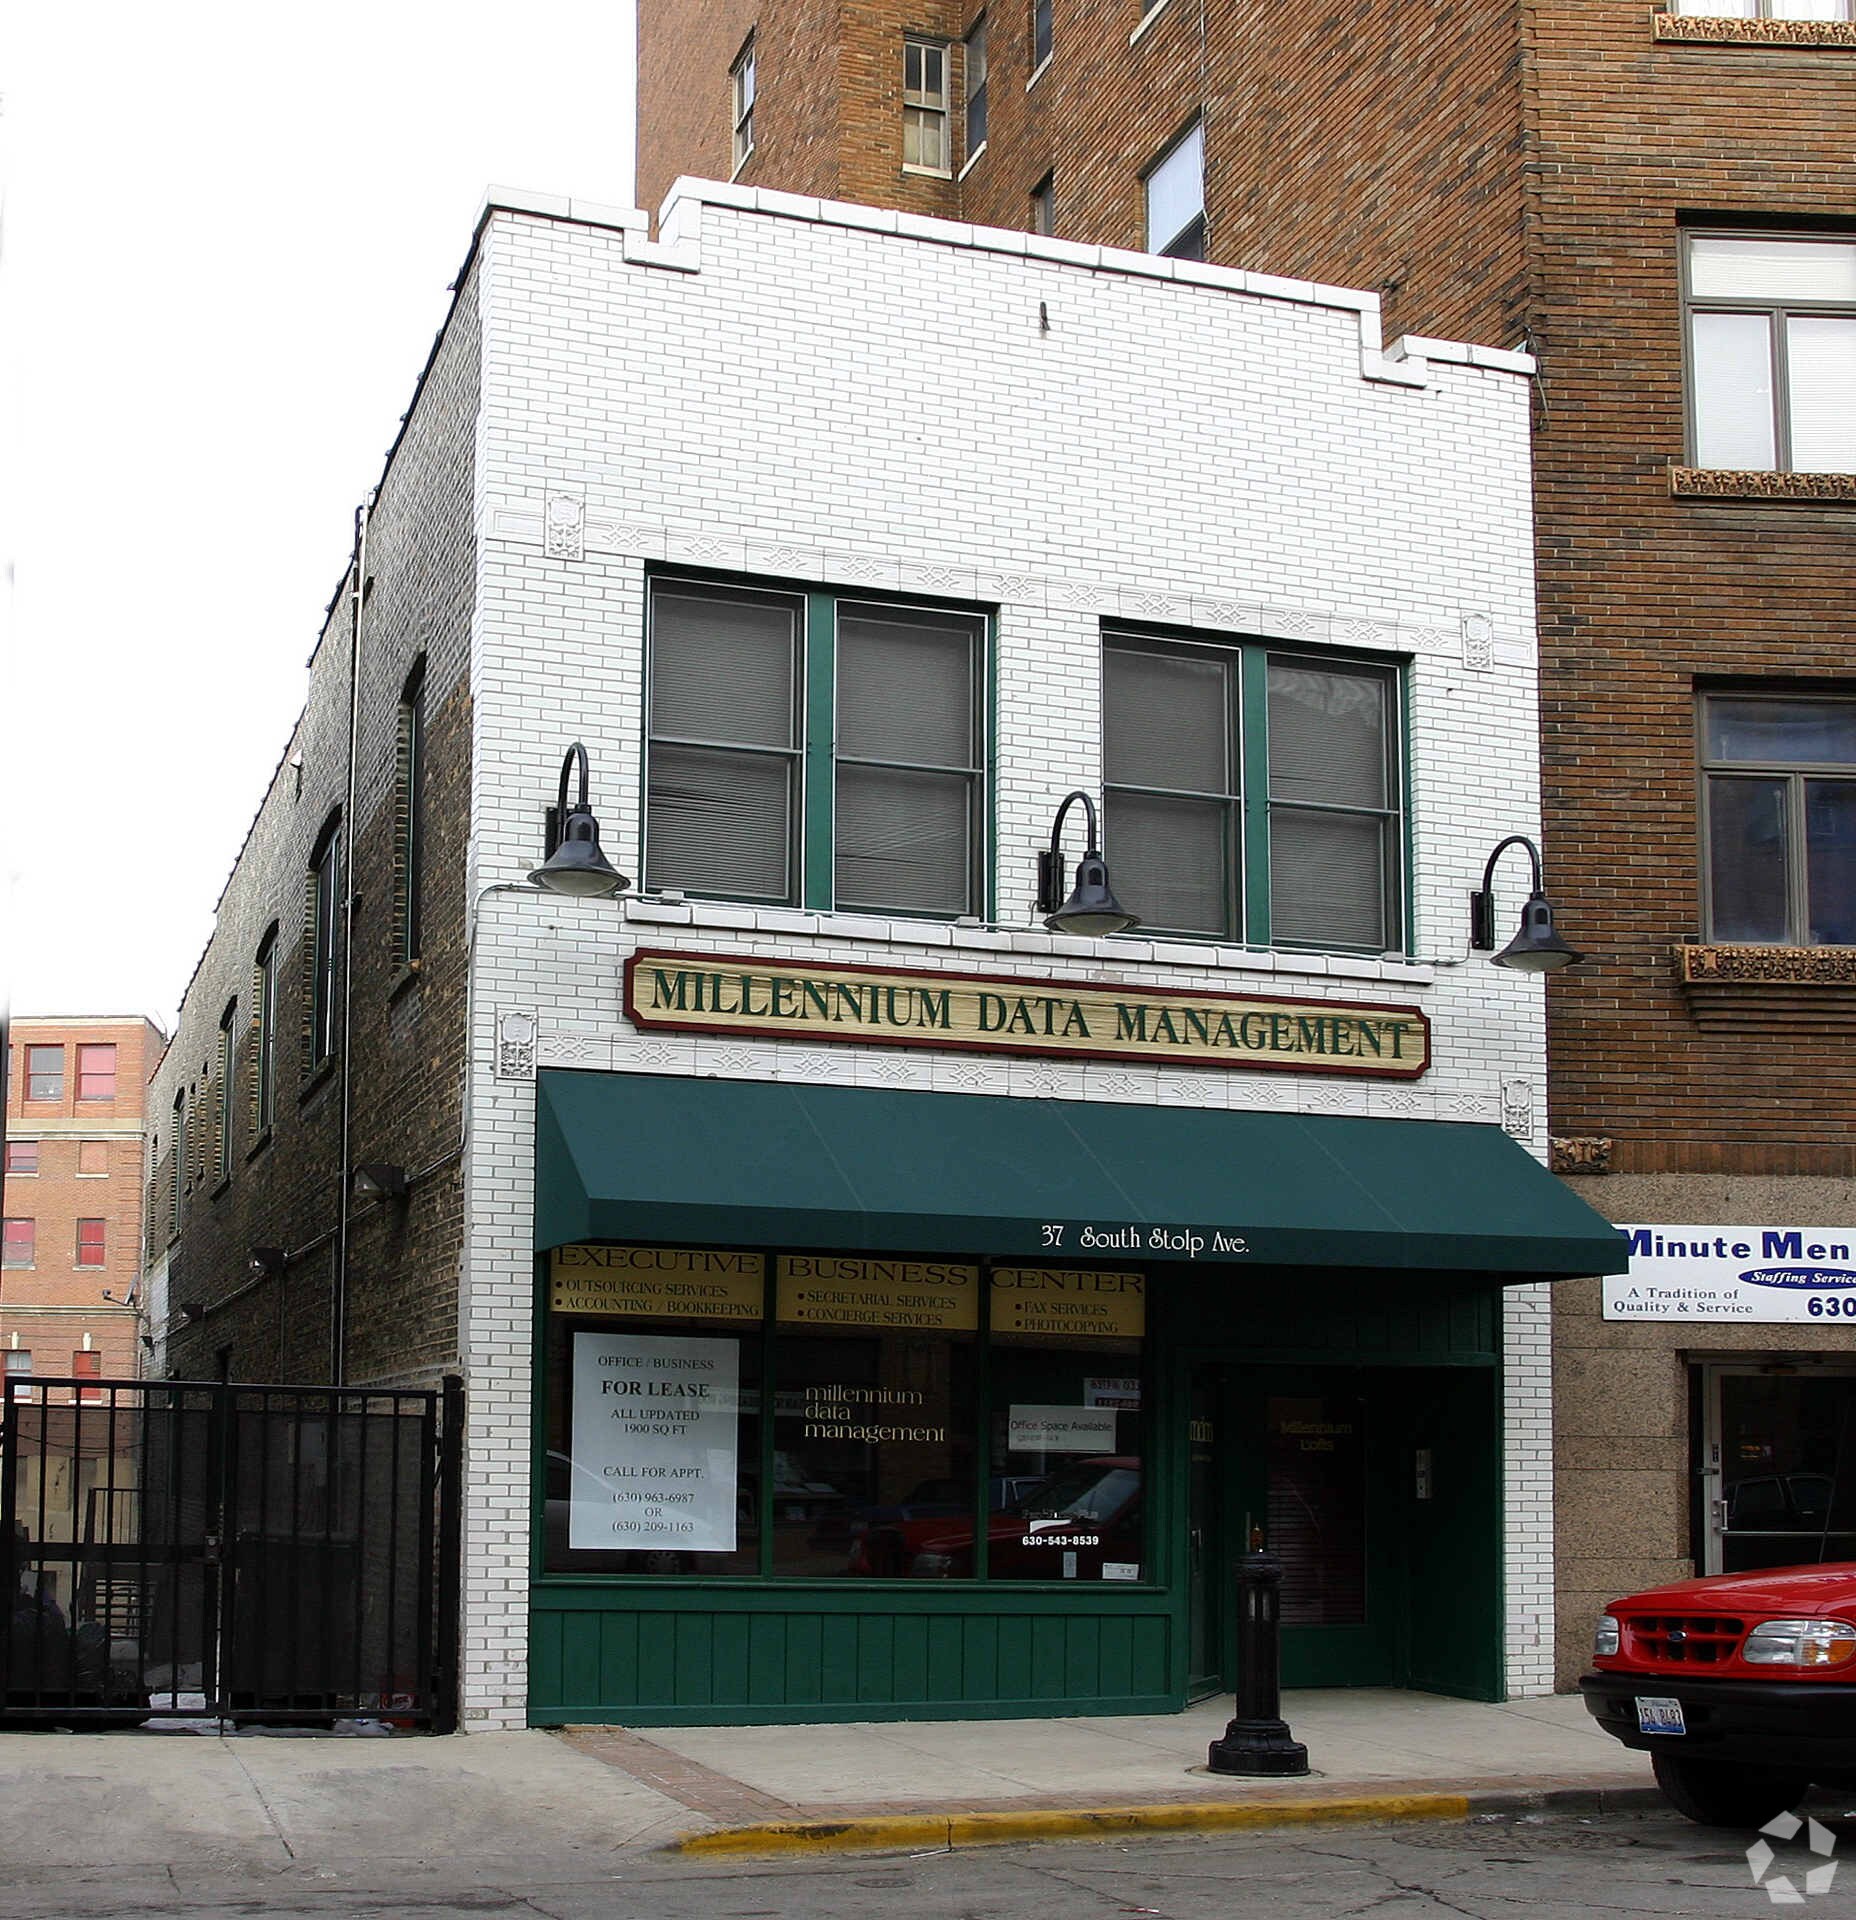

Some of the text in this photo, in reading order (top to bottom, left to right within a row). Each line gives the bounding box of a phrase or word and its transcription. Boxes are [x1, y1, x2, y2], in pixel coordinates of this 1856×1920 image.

[650, 968, 1409, 1060] MILLENNIUM DATA MANAGEMENT
[1041, 1225, 1250, 1259] 37 South Stolp Ave.
[1616, 1229, 1850, 1260] Minute Men
[557, 1247, 759, 1274] EXECUTIVE
[787, 1258, 969, 1285] BUSINESS
[1751, 1271, 1807, 1285] Staffing
[566, 1279, 729, 1298] OUTSOURCING SERVICES
[990, 1269, 1145, 1294] CENTER
[807, 1289, 957, 1309] SECRETARIAL SERVICES
[1629, 1287, 1739, 1300] A Tradition of
[566, 1297, 652, 1312] ACCOUNTING
[667, 1300, 760, 1317] BOOKKEEPING
[807, 1306, 943, 1326] CONCIERGE SERVICES
[1051, 1302, 1109, 1316] SERVICES
[1614, 1301, 1753, 1315] Quality & Service
[1807, 1296, 1856, 1318] 630
[1024, 1317, 1119, 1334] PHOTOCOPYING
[598, 1356, 643, 1367] OFFICE
[653, 1358, 715, 1370] BUSINESS
[602, 1380, 711, 1398] FOR LEASE
[804, 1384, 923, 1405] millennium
[611, 1409, 701, 1421] ALL UPDATED
[805, 1402, 851, 1420] data
[624, 1424, 688, 1437] 1900 SQ FT
[804, 1423, 946, 1444] management
[1010, 1421, 1039, 1431] Office
[1041, 1421, 1069, 1433] Space
[603, 1466, 705, 1479] CALL FOR APPT.
[612, 1493, 642, 1504] (630)
[644, 1507, 663, 1518] OR
[612, 1522, 641, 1533] (630)
